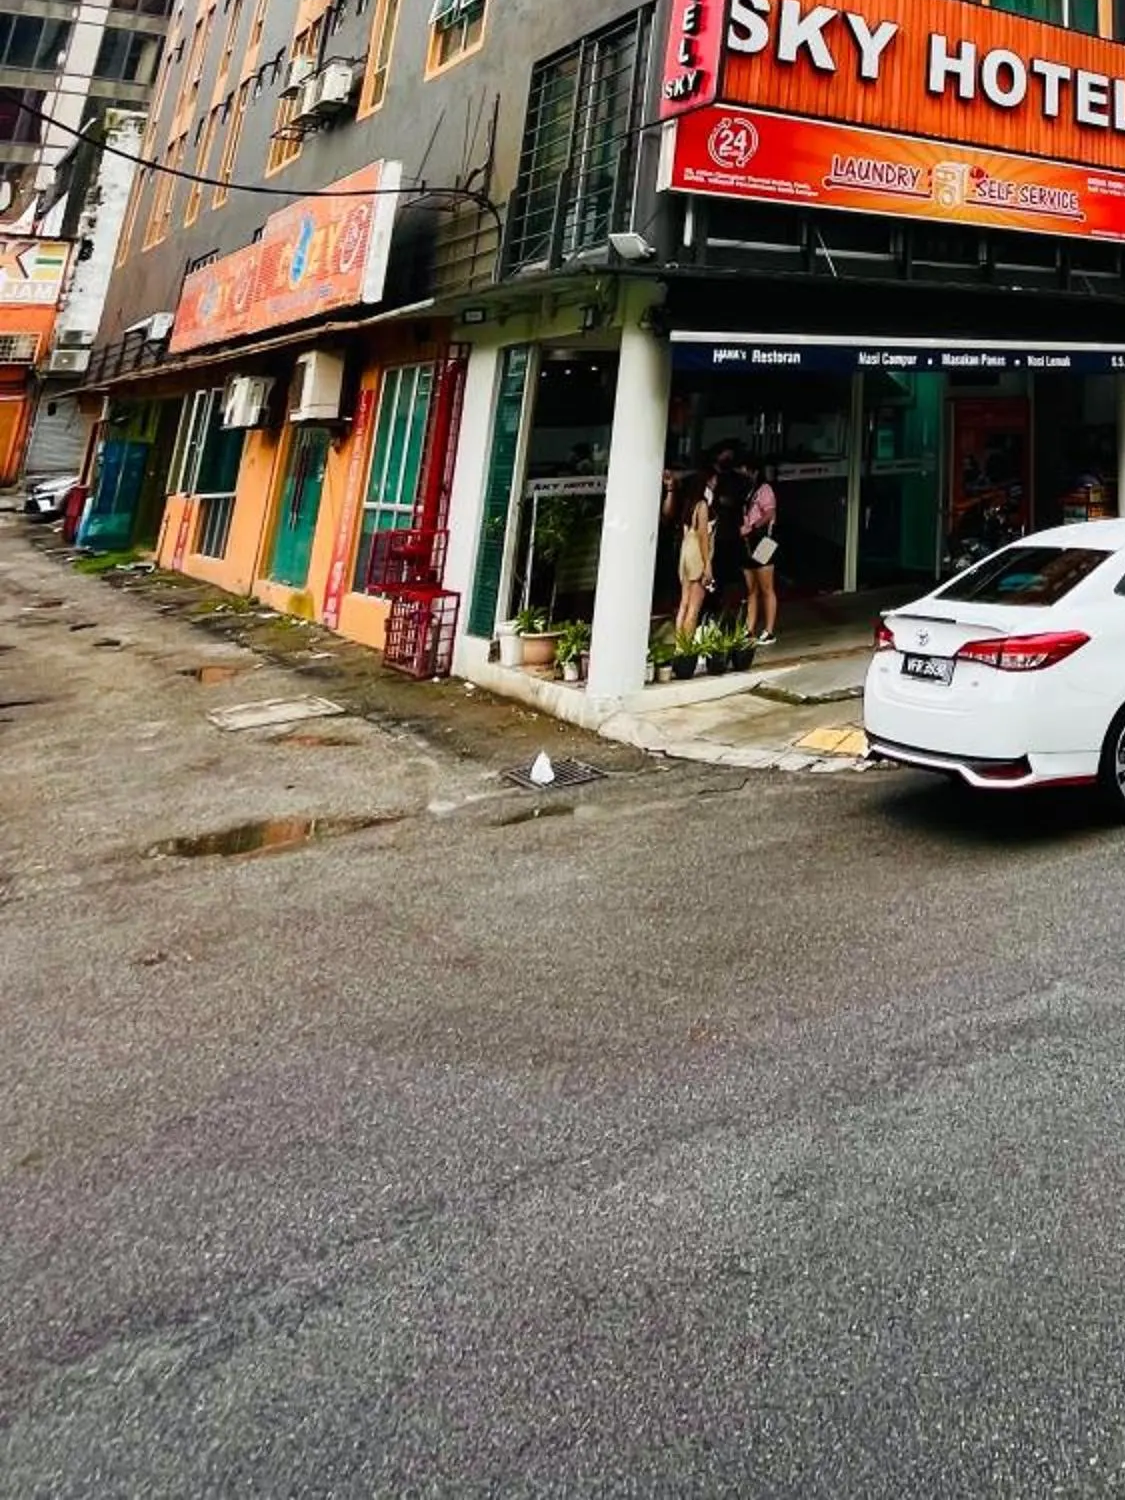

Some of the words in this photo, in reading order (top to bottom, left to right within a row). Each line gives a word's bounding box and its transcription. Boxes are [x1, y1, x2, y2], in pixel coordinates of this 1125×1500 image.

[664, 71, 698, 99] SKY
[719, 129, 748, 150] 24
[831, 154, 921, 189] LAUNDRY
[976, 179, 1014, 202] SELF
[1019, 184, 1079, 212] SERVICE
[752, 349, 800, 363] Restoran
